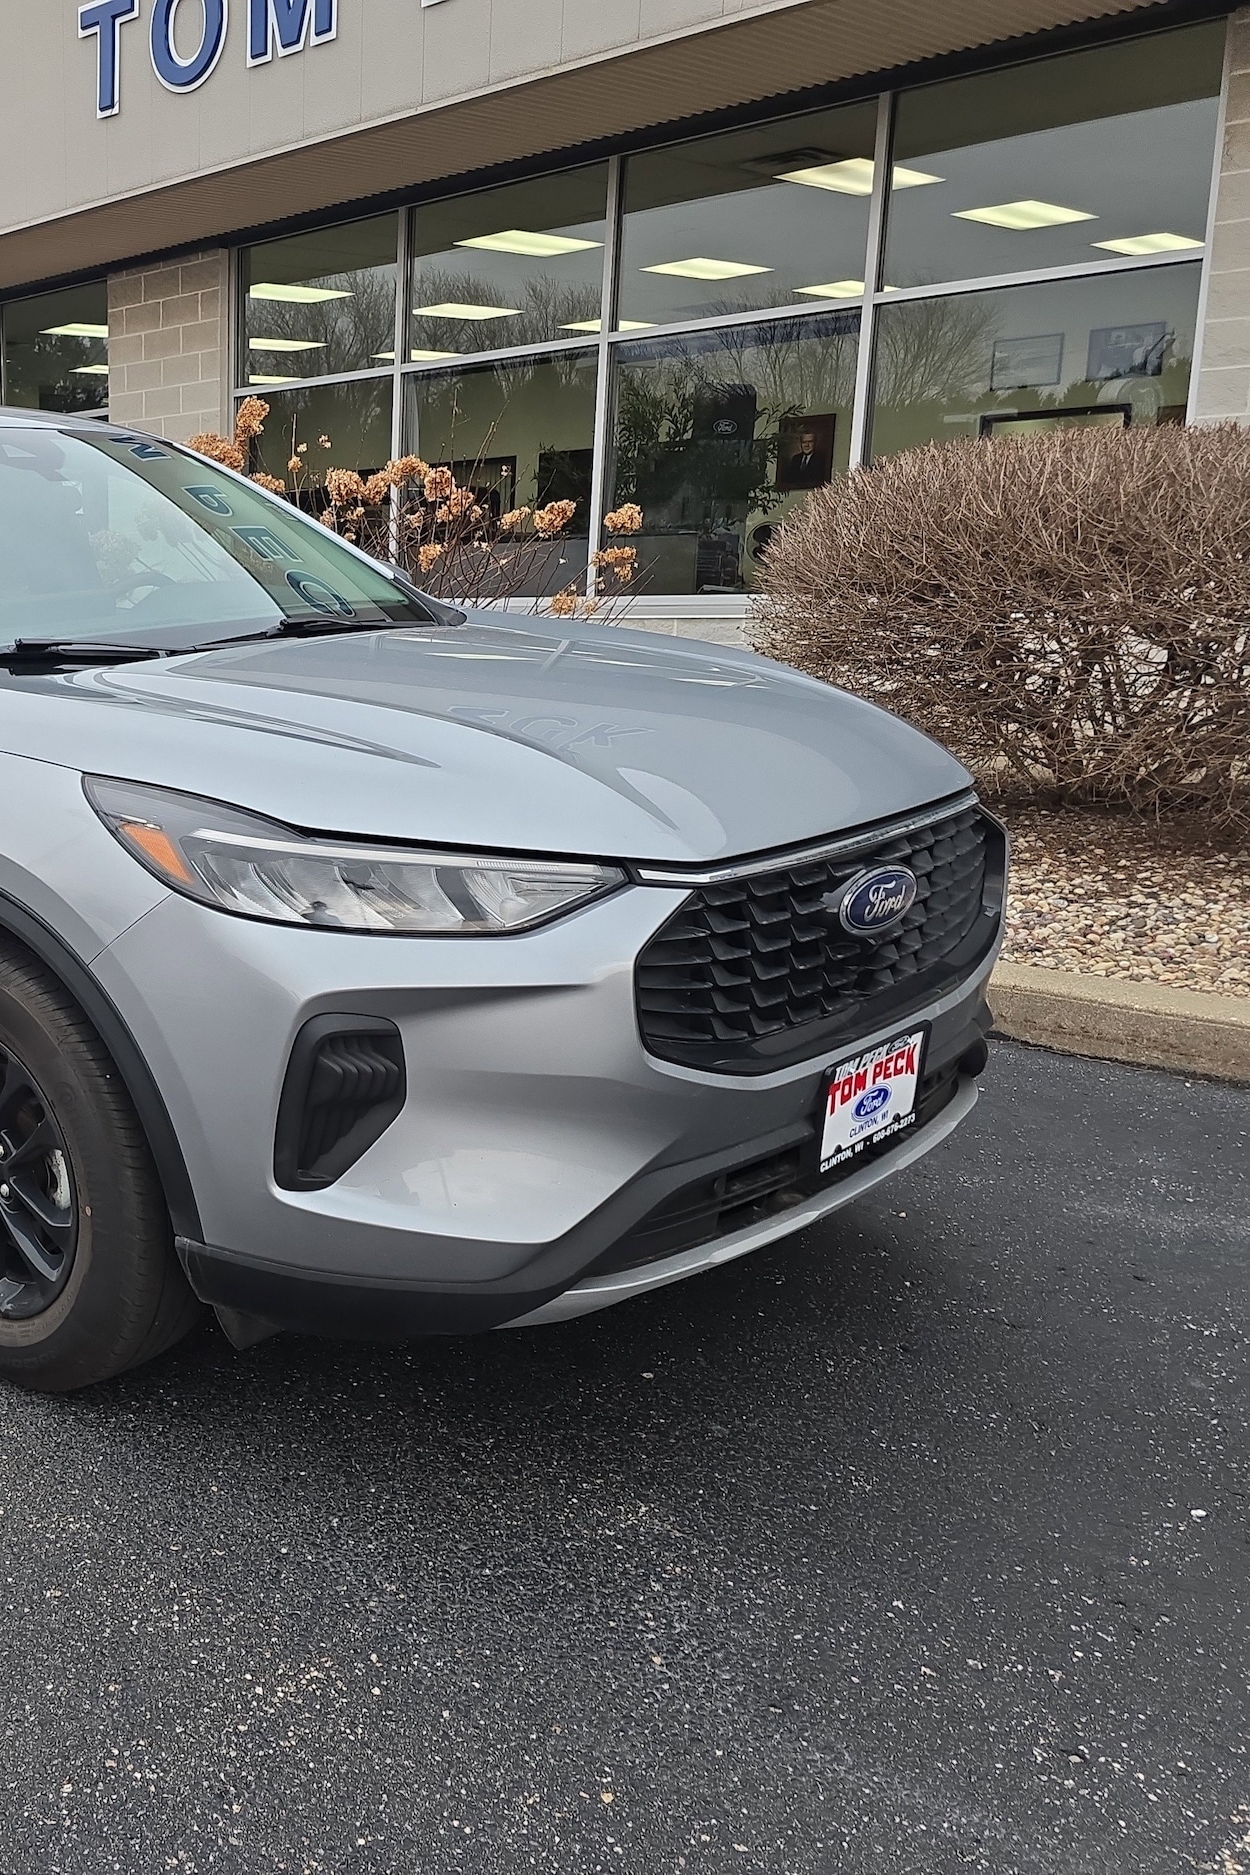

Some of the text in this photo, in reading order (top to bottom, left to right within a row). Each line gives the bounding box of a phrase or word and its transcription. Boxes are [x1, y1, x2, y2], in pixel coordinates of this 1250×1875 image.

[77, 0, 338, 119] TOM
[863, 880, 906, 922] Ford
[827, 1042, 918, 1117] TOM PECK
[860, 1090, 885, 1116] Ford
[819, 1148, 854, 1173] CLINTON,
